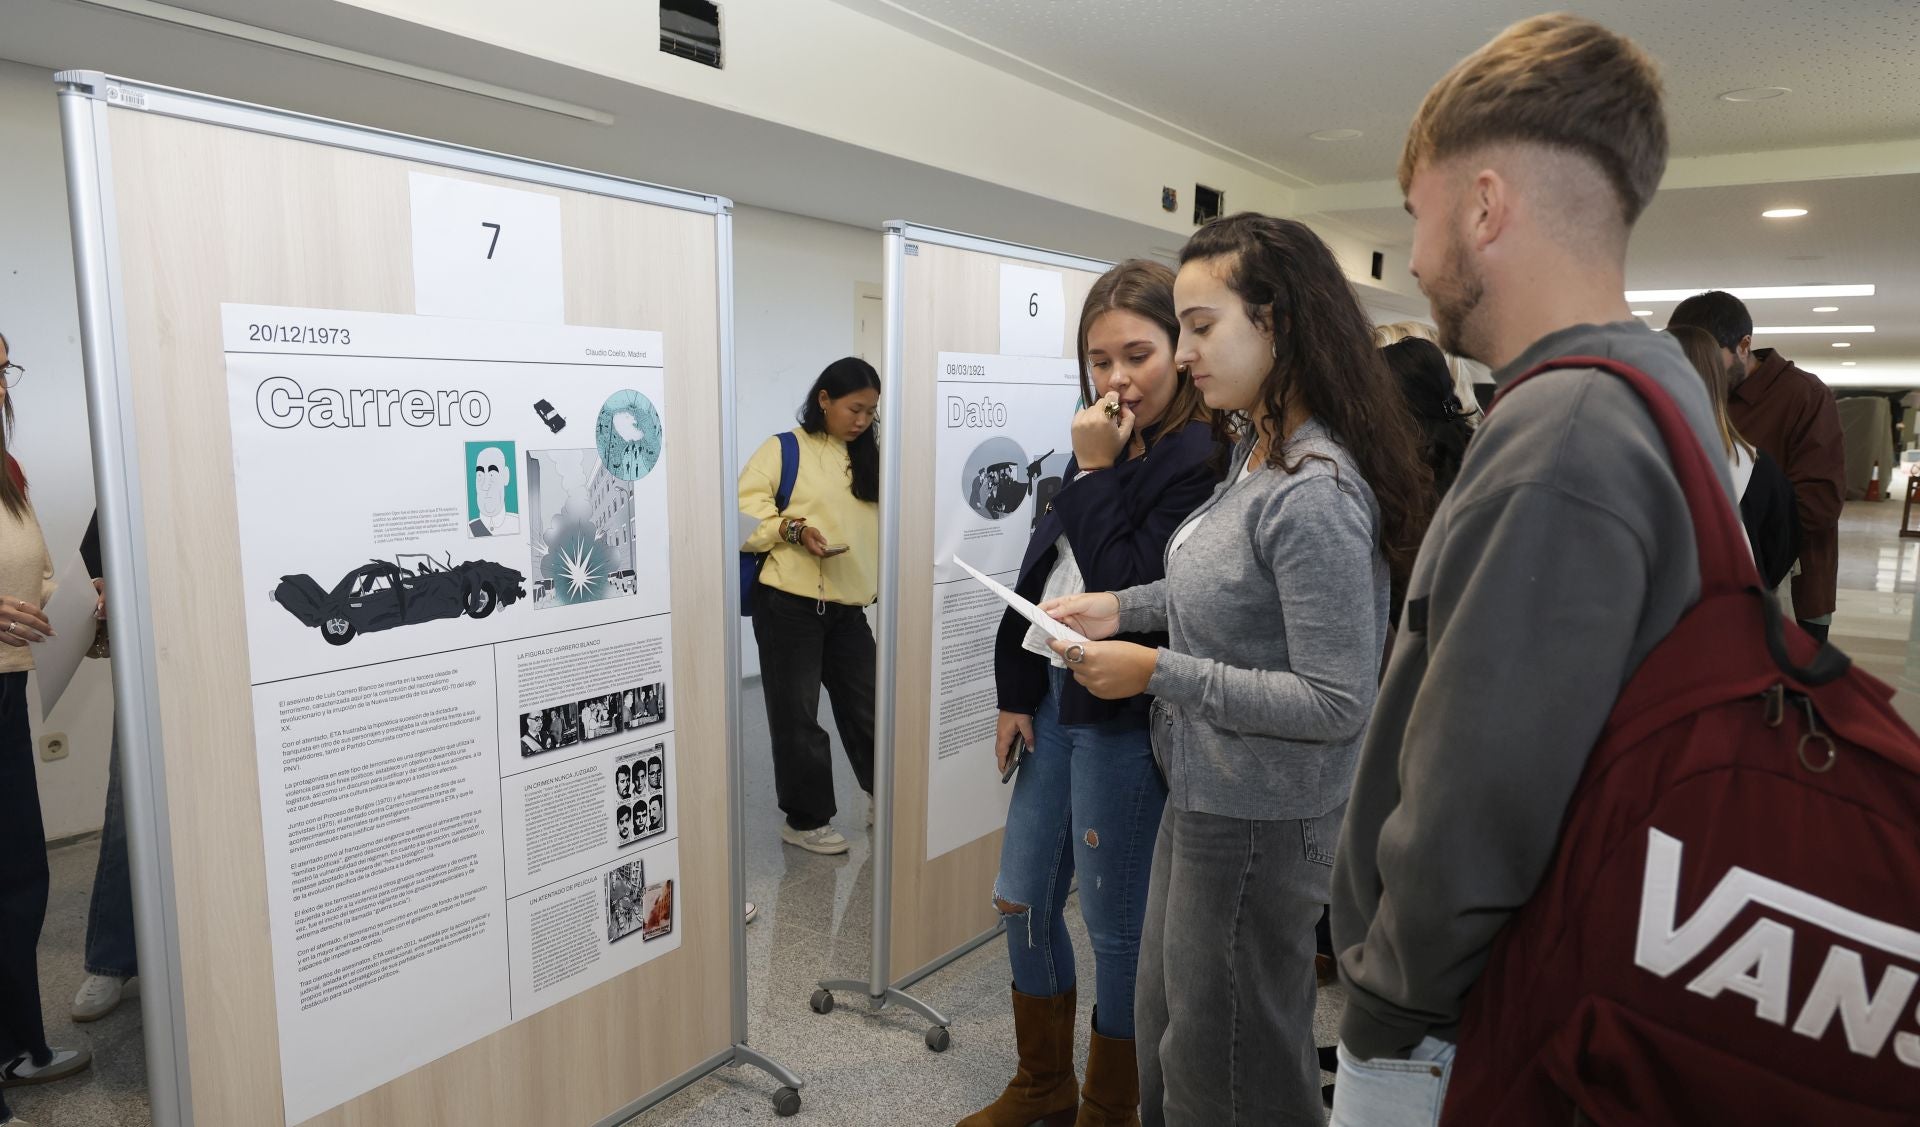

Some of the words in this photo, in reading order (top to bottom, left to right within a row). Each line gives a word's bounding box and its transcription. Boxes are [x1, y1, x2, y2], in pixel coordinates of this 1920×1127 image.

[482, 222, 500, 259] 7
[1029, 292, 1038, 317] 6
[249, 324, 351, 345] 20/12/1973
[585, 348, 607, 356] Claudio
[628, 350, 647, 358] Madrid
[947, 364, 985, 376] 08/03/1921
[256, 376, 491, 429] Carrero
[947, 395, 1007, 428] Dato
[525, 648, 545, 658] FIGURA
[545, 647, 553, 655] DE
[554, 643, 580, 654] CARRERO
[580, 639, 601, 649] BLANCO
[533, 778, 554, 788] CRIMEN
[554, 773, 572, 782] NUNCA
[574, 766, 598, 777] JUZGADO
[538, 888, 565, 902] ATENTADO
